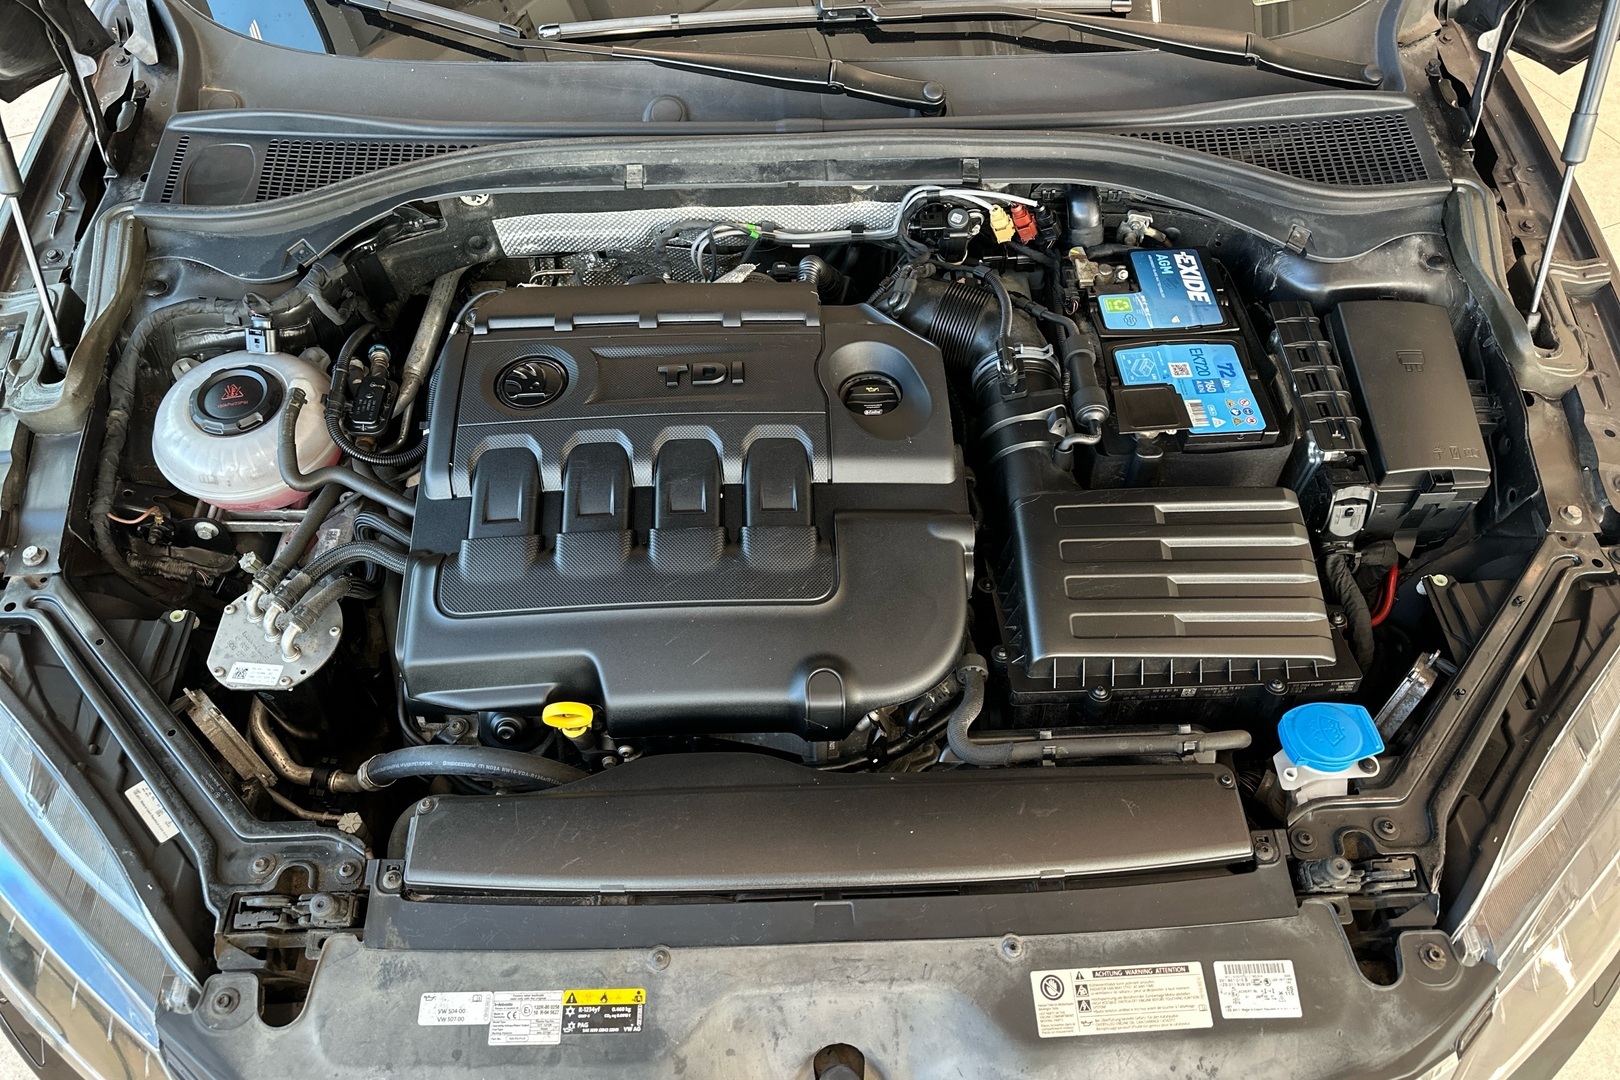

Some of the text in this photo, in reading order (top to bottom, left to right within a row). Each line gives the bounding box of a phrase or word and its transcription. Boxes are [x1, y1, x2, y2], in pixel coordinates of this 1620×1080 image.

[1156, 254, 1174, 274] AGM
[1173, 251, 1212, 304] EXIDE
[656, 361, 745, 387] TDI
[1189, 348, 1210, 376] EK720
[1217, 362, 1236, 388] 72 Ah
[1204, 380, 1216, 392] 760
[1156, 966, 1186, 974] ATTENTION
